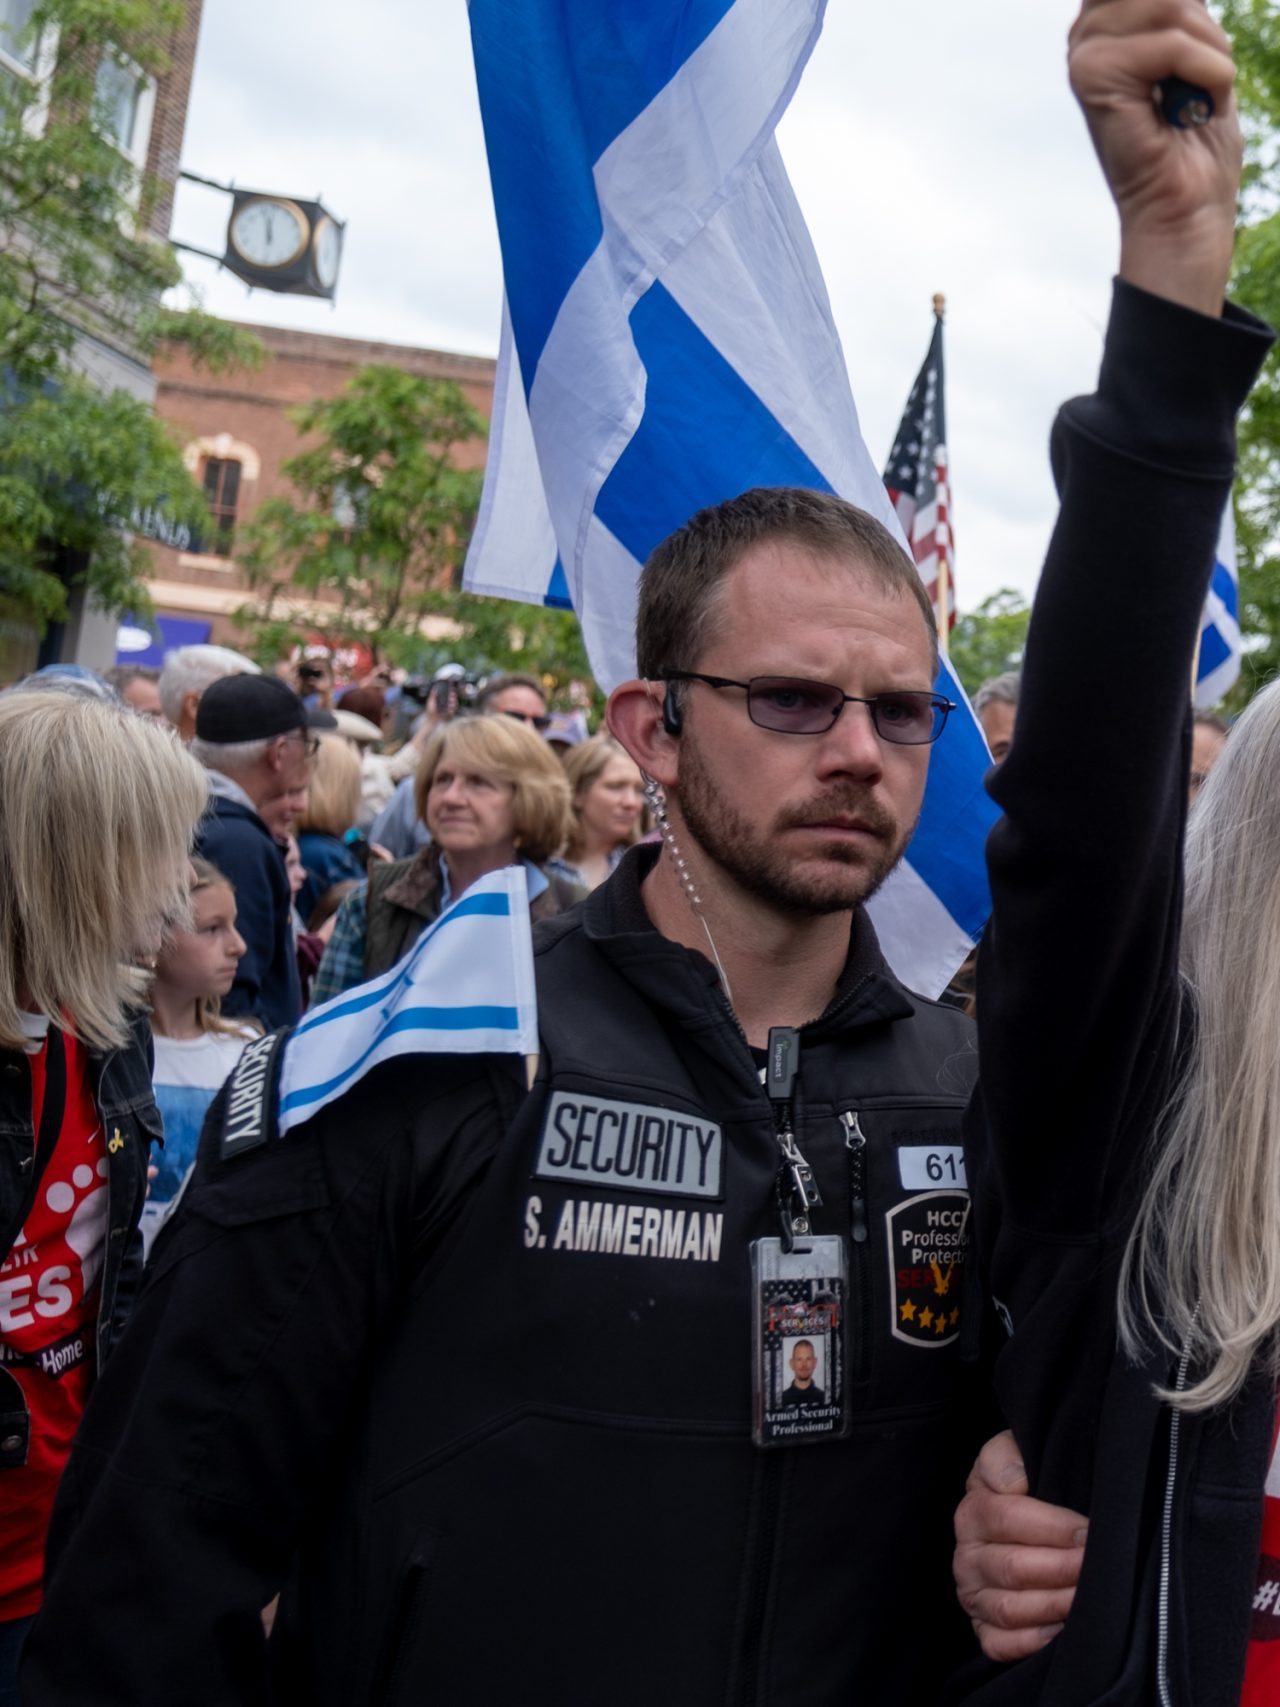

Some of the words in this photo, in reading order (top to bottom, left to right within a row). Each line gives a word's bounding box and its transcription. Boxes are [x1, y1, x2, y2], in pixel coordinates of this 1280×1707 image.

[224, 1034, 278, 1142] SECURITY
[546, 1102, 717, 1187] SECURITY
[524, 1195, 547, 1249] S.
[553, 1200, 724, 1263] AMMERMAN
[766, 1409, 798, 1422] Armed
[801, 1406, 841, 1419] Security
[773, 1419, 833, 1436] Professional
